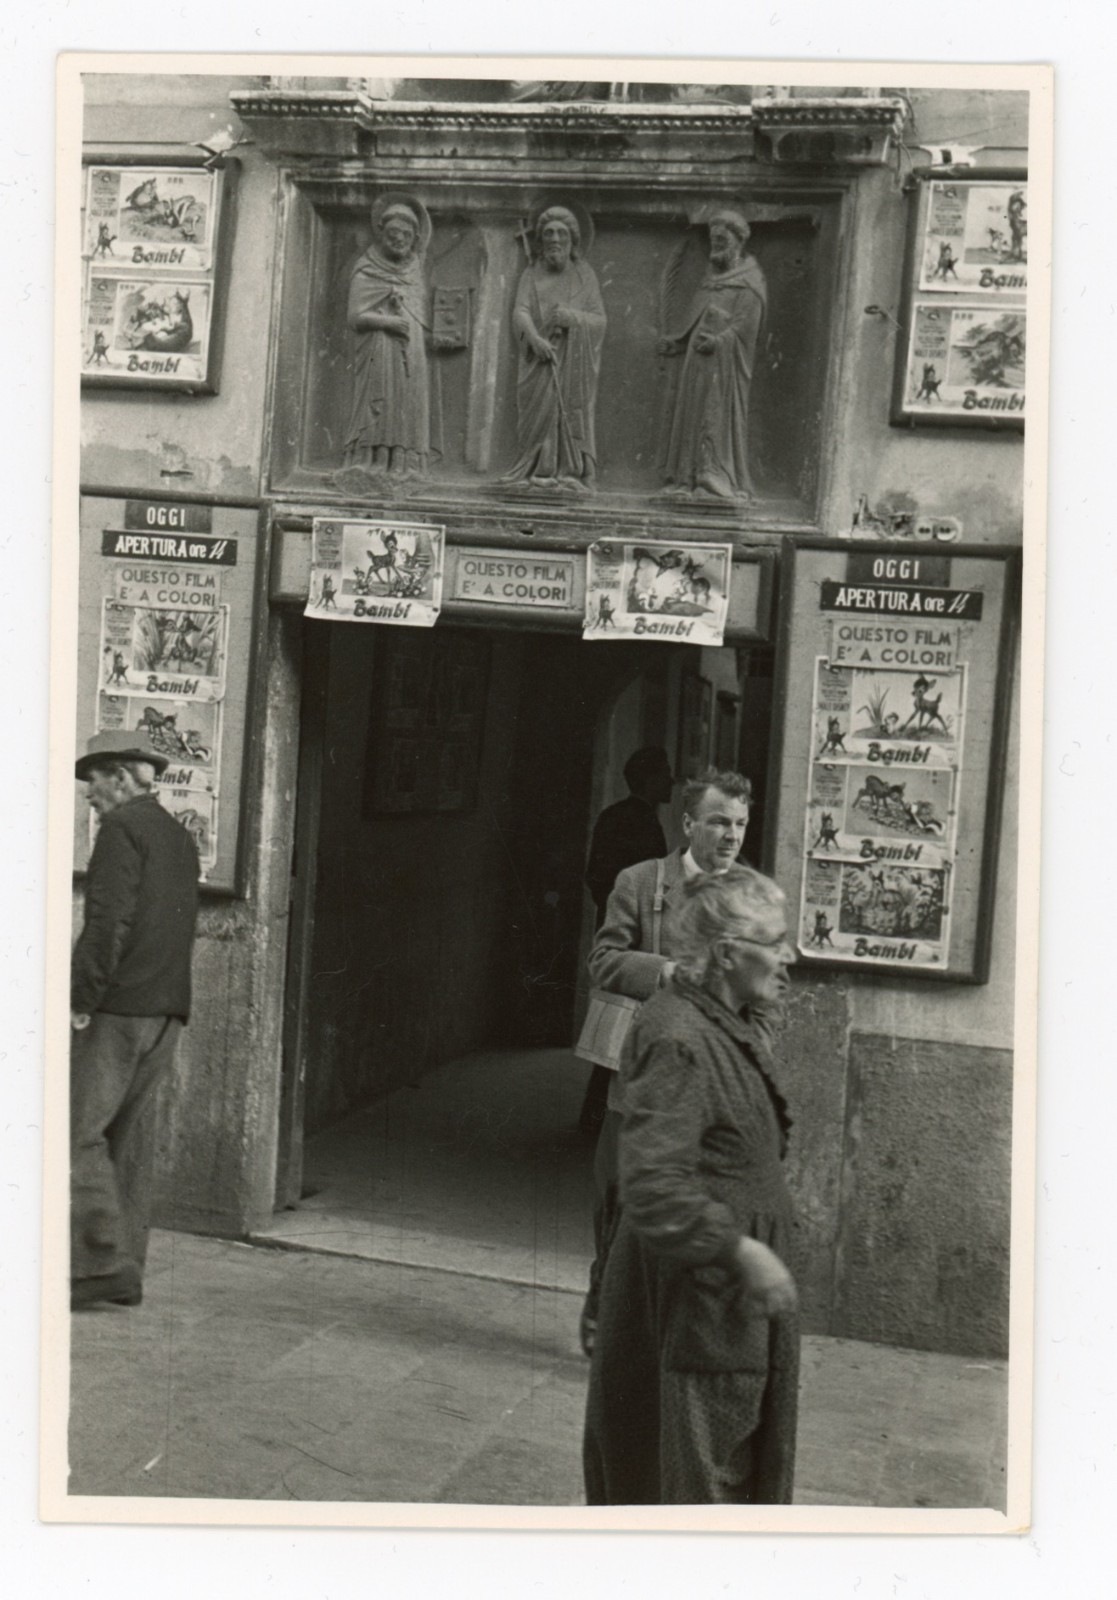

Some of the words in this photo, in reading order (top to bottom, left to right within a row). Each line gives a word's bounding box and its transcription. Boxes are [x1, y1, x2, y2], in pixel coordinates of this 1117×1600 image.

[131, 245, 185, 264] Bambi
[979, 268, 1027, 288] Bam
[127, 354, 181, 373] Bambi
[146, 506, 185, 527] OGGI
[115, 535, 188, 558] APERTURA
[189, 545, 206, 558] ore
[122, 568, 180, 585] QUESTO
[185, 573, 215, 588] FILM
[464, 561, 527, 578] QUESTO
[533, 566, 566, 581] FILM
[873, 558, 919, 579] OGGI
[140, 590, 149, 601] A
[157, 590, 215, 606] COLORI
[483, 583, 494, 596] A
[502, 583, 566, 600] COLORI
[835, 587, 921, 612] APERTURA
[924, 598, 944, 612] ore
[354, 599, 411, 619] Bambi
[633, 616, 695, 637] Bambi
[838, 626, 908, 645] QUESTO
[915, 630, 951, 646] FILM
[860, 648, 872, 661] A
[881, 649, 951, 666] COLORI
[146, 674, 199, 694] Bambi
[867, 742, 932, 764] Bambi
[154, 769, 193, 785] ambi
[859, 839, 924, 861] Bambi
[854, 937, 918, 960] Bambi
